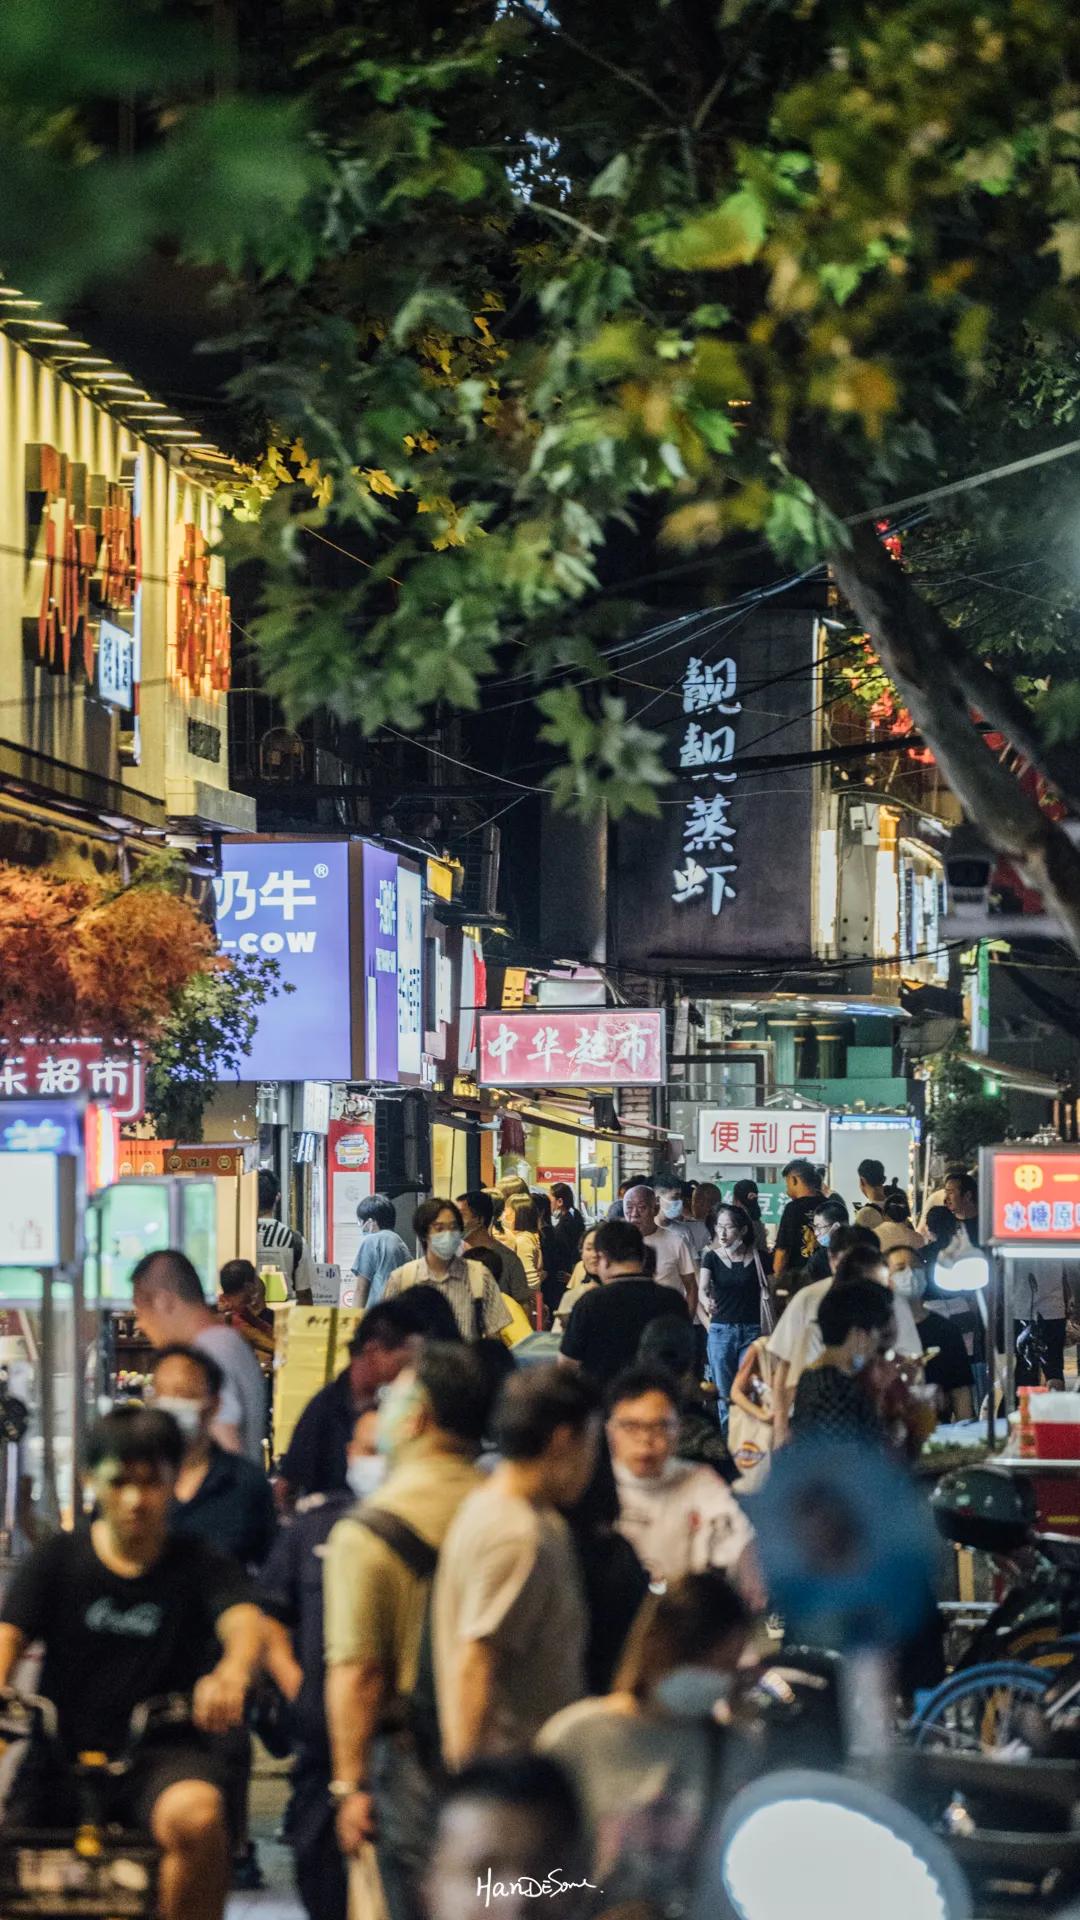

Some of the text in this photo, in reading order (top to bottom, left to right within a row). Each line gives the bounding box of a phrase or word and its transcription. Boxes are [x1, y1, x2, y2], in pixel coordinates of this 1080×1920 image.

[671, 656, 742, 917] 靓靓蒸虾
[487, 1023, 653, 1076] 中华超市
[710, 1121, 817, 1155] 便利店
